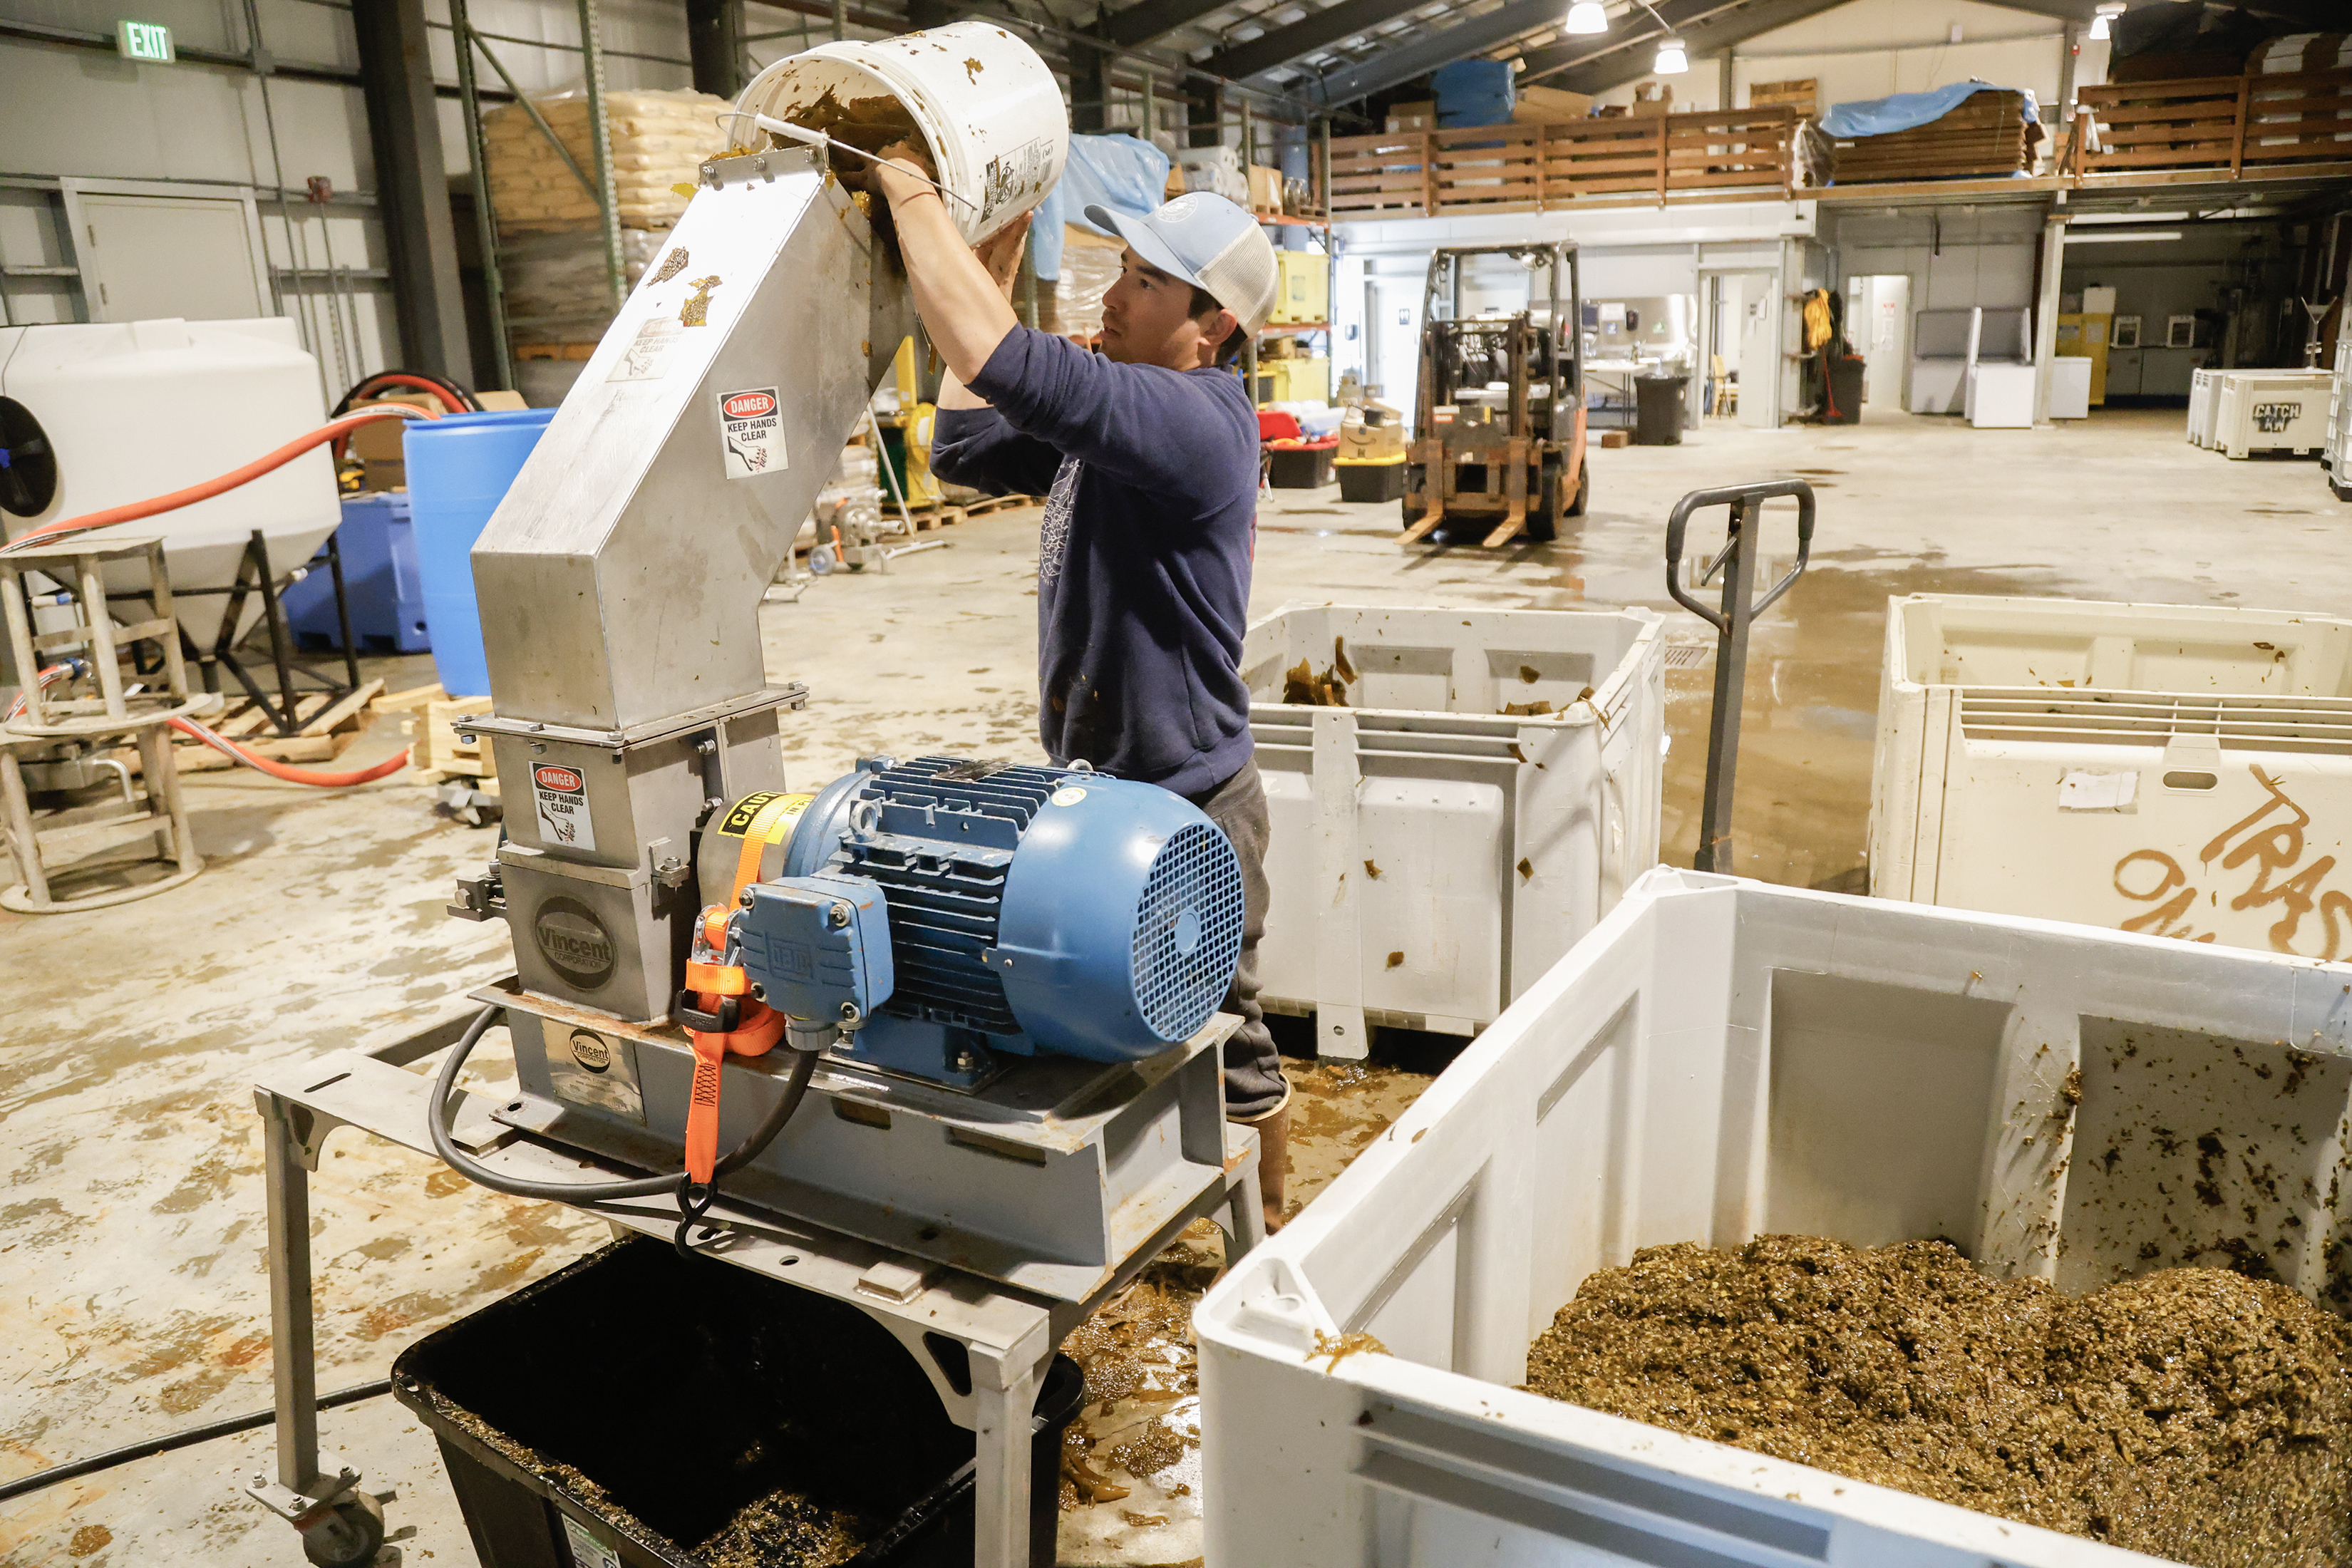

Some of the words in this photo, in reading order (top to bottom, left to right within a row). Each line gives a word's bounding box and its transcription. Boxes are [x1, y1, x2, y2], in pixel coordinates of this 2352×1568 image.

[126, 21, 168, 59] EXIT
[634, 338, 654, 346] KEEP
[639, 345, 664, 354] CLEAR
[731, 396, 769, 413] DANGER
[2254, 404, 2300, 418] CATCH
[727, 422, 748, 433] KEEP
[750, 418, 777, 430] HANDS
[741, 430, 767, 442] CLEAR
[542, 770, 576, 788] DANGER
[539, 791, 557, 801] KEEP
[558, 794, 584, 806] HANDS
[551, 803, 574, 815] CLEAR
[730, 791, 783, 827] CAUT
[538, 926, 611, 961] Vincent
[555, 951, 602, 968] CORPORATION
[572, 1040, 609, 1060] Vincent
[577, 1053, 606, 1064] CORPORATION
